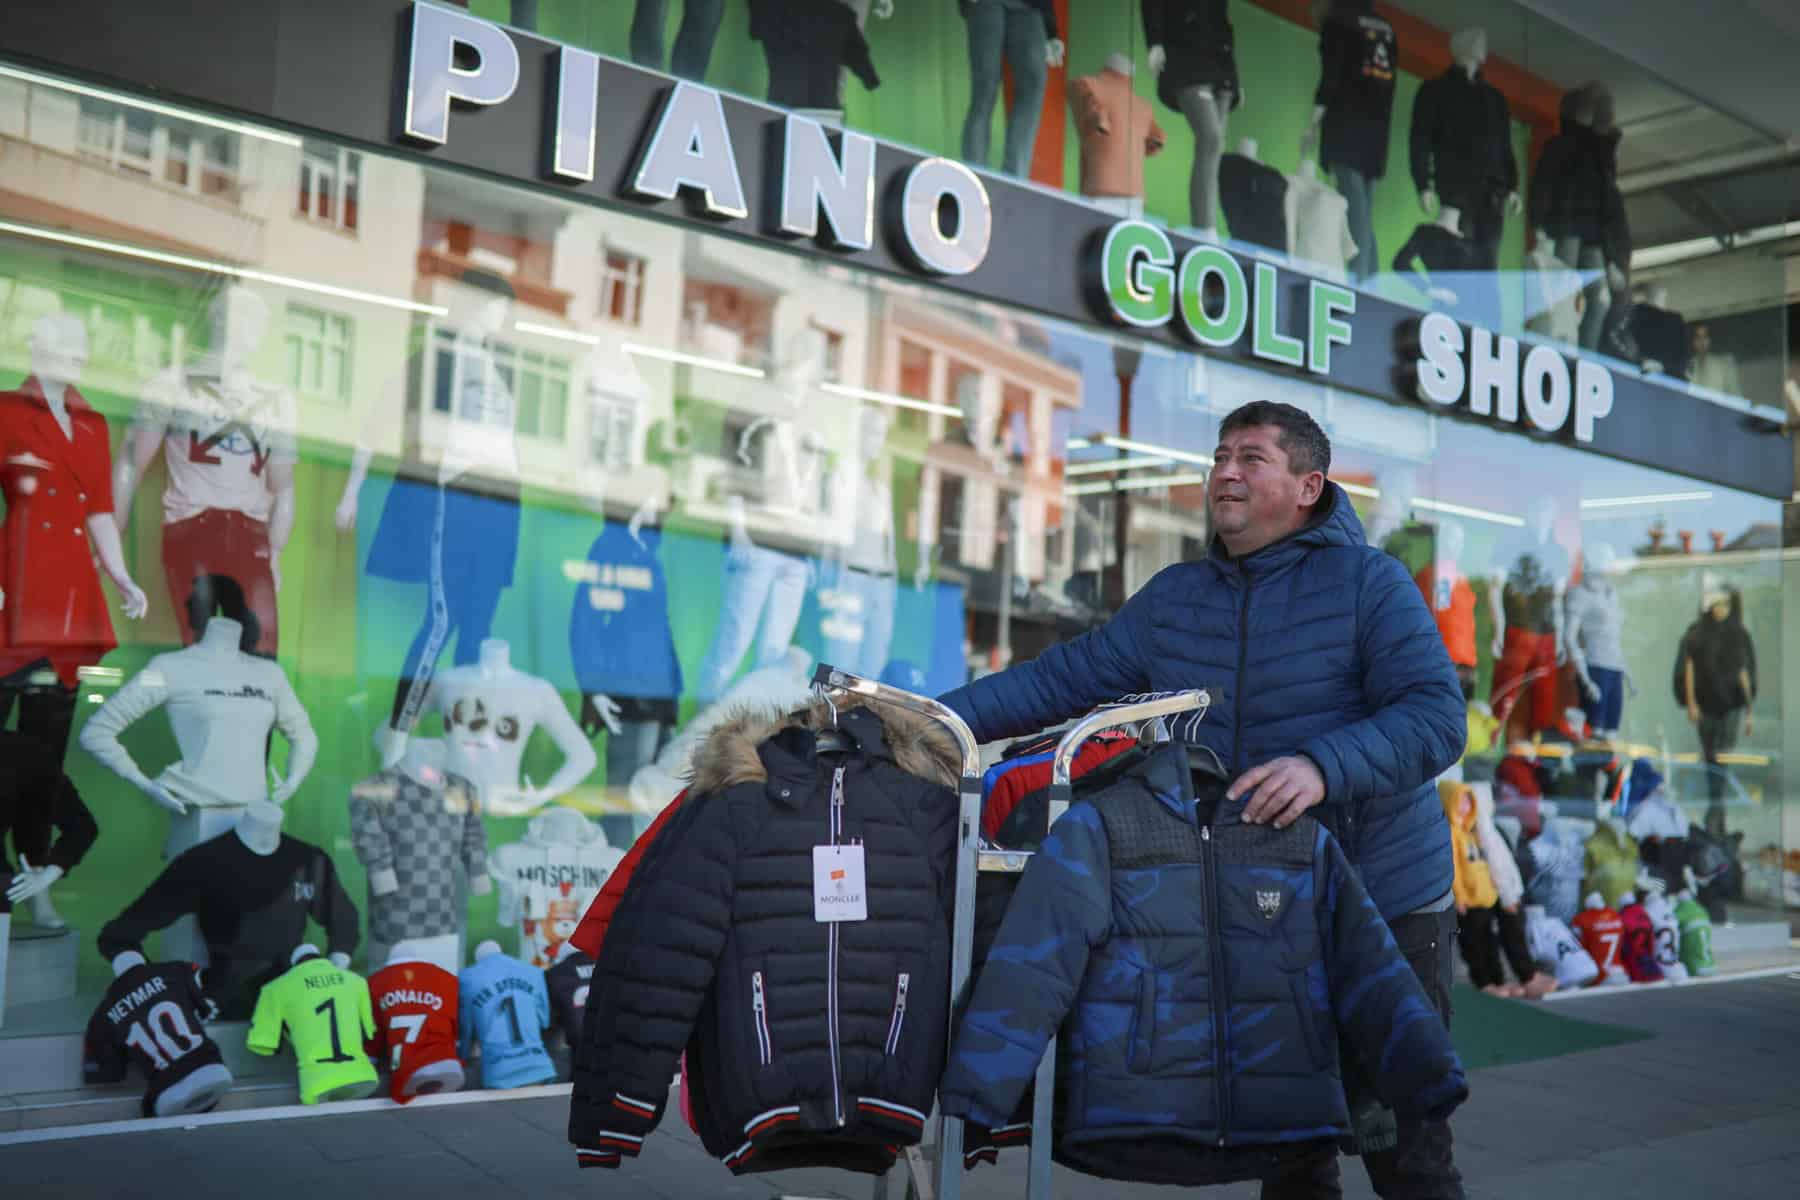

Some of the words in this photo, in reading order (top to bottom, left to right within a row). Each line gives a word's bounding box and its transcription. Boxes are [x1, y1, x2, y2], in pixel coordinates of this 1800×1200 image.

[405, 1, 991, 276] PIANO
[1101, 219, 1356, 375] GOLF
[1416, 311, 1615, 442] SHOP
[106, 976, 168, 1025] NEYMAR
[315, 997, 356, 1064] 1
[497, 996, 525, 1045] 1
[125, 1000, 204, 1071] 10
[389, 1013, 429, 1071] 7
